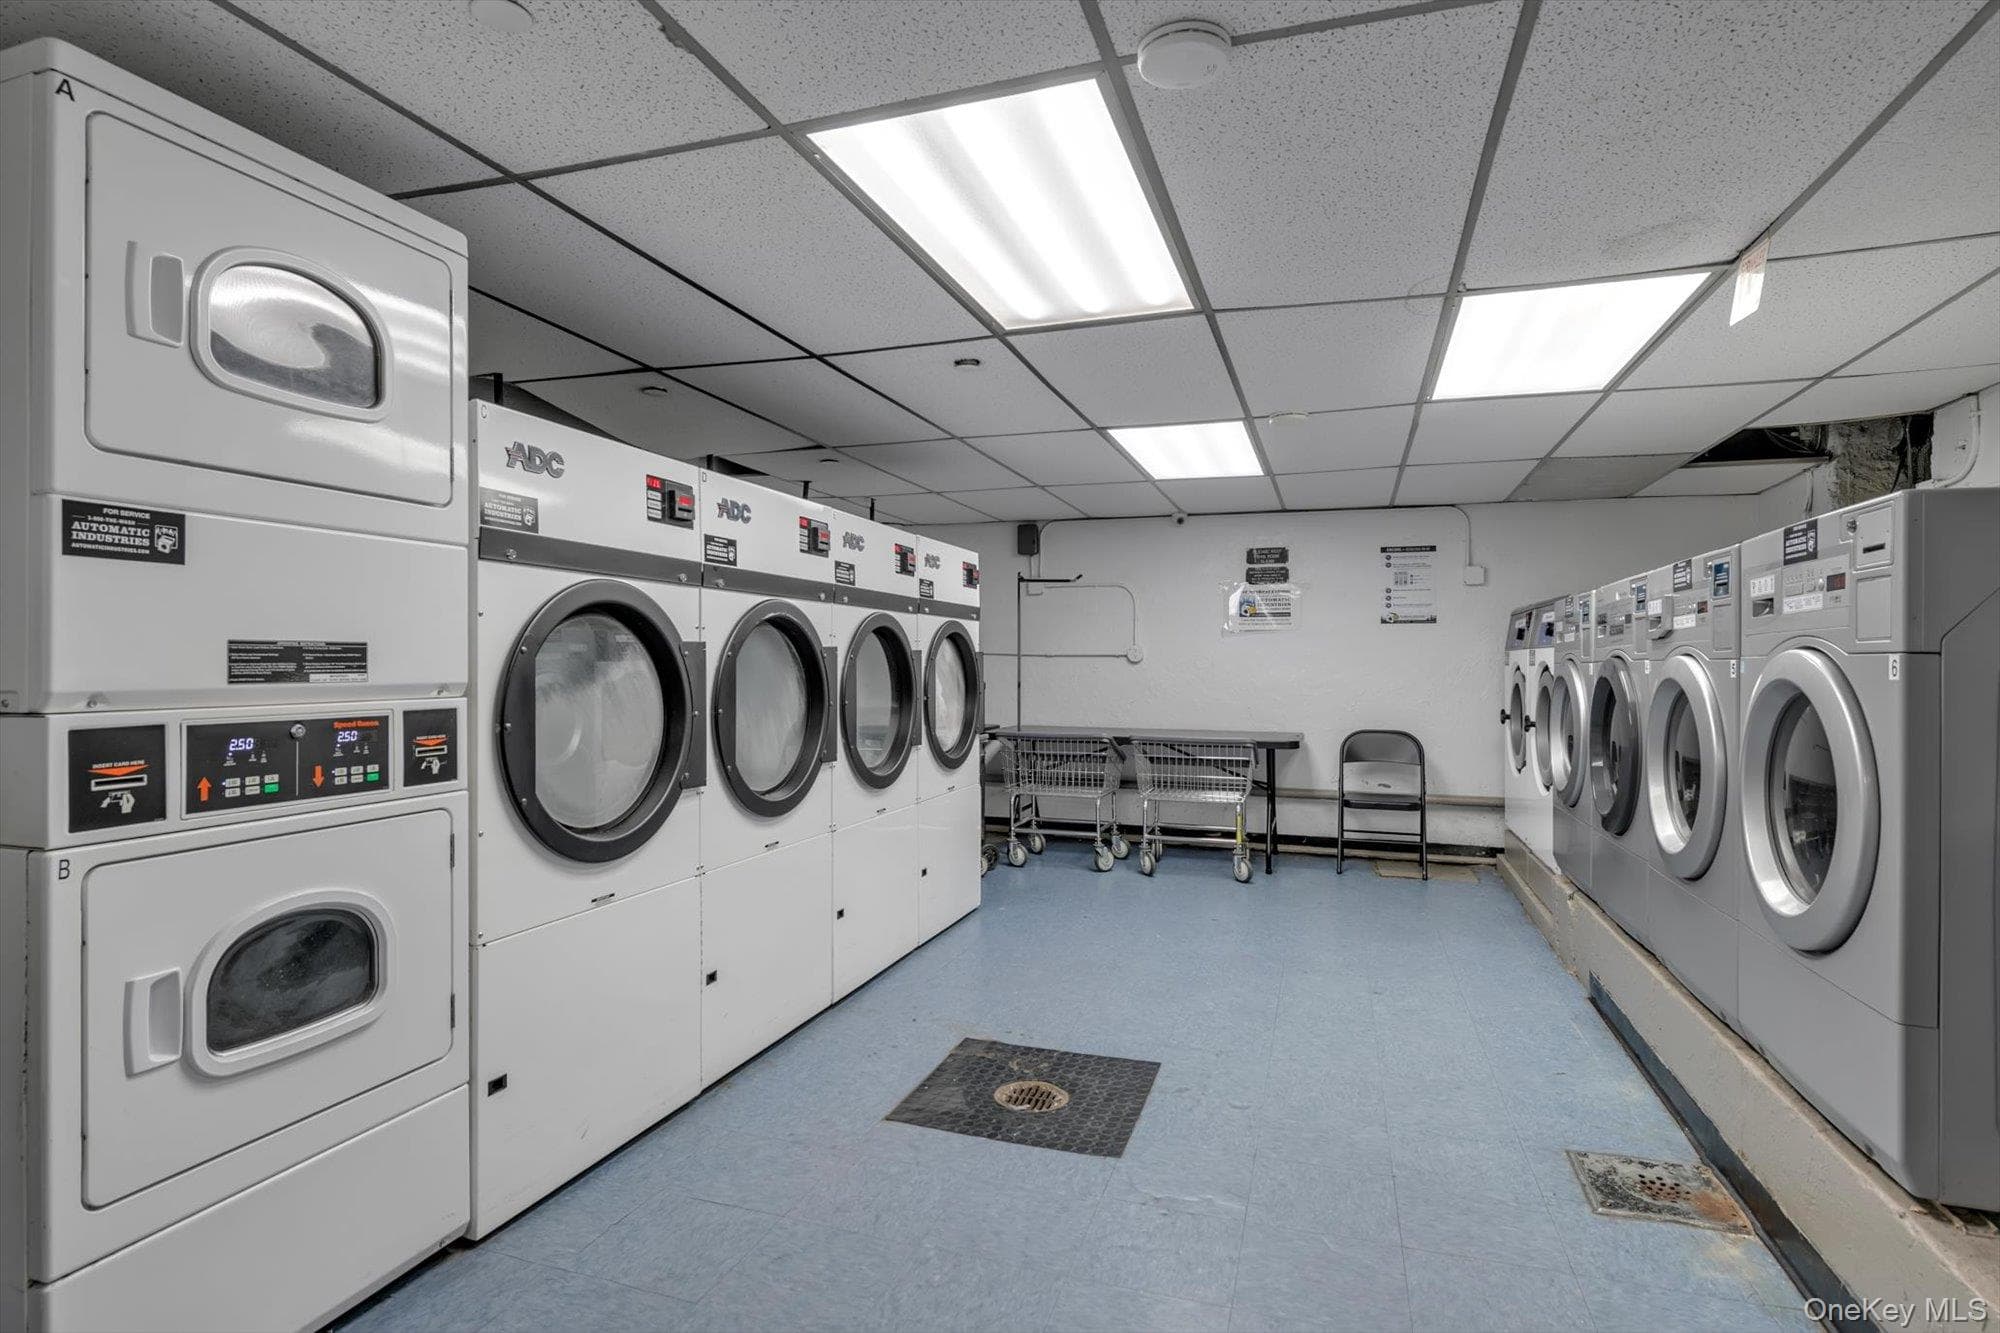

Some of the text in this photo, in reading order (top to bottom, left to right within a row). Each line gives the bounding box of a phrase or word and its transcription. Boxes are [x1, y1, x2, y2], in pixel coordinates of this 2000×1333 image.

[55, 79, 75, 102] A
[505, 441, 565, 478] ADC
[120, 510, 151, 519] SERVICE
[716, 498, 752, 524] ADC
[71, 521, 150, 537] AUTOMATIC
[71, 531, 150, 547] INDUSTRIES
[1891, 659, 1898, 677] 6
[59, 859, 70, 879] B
